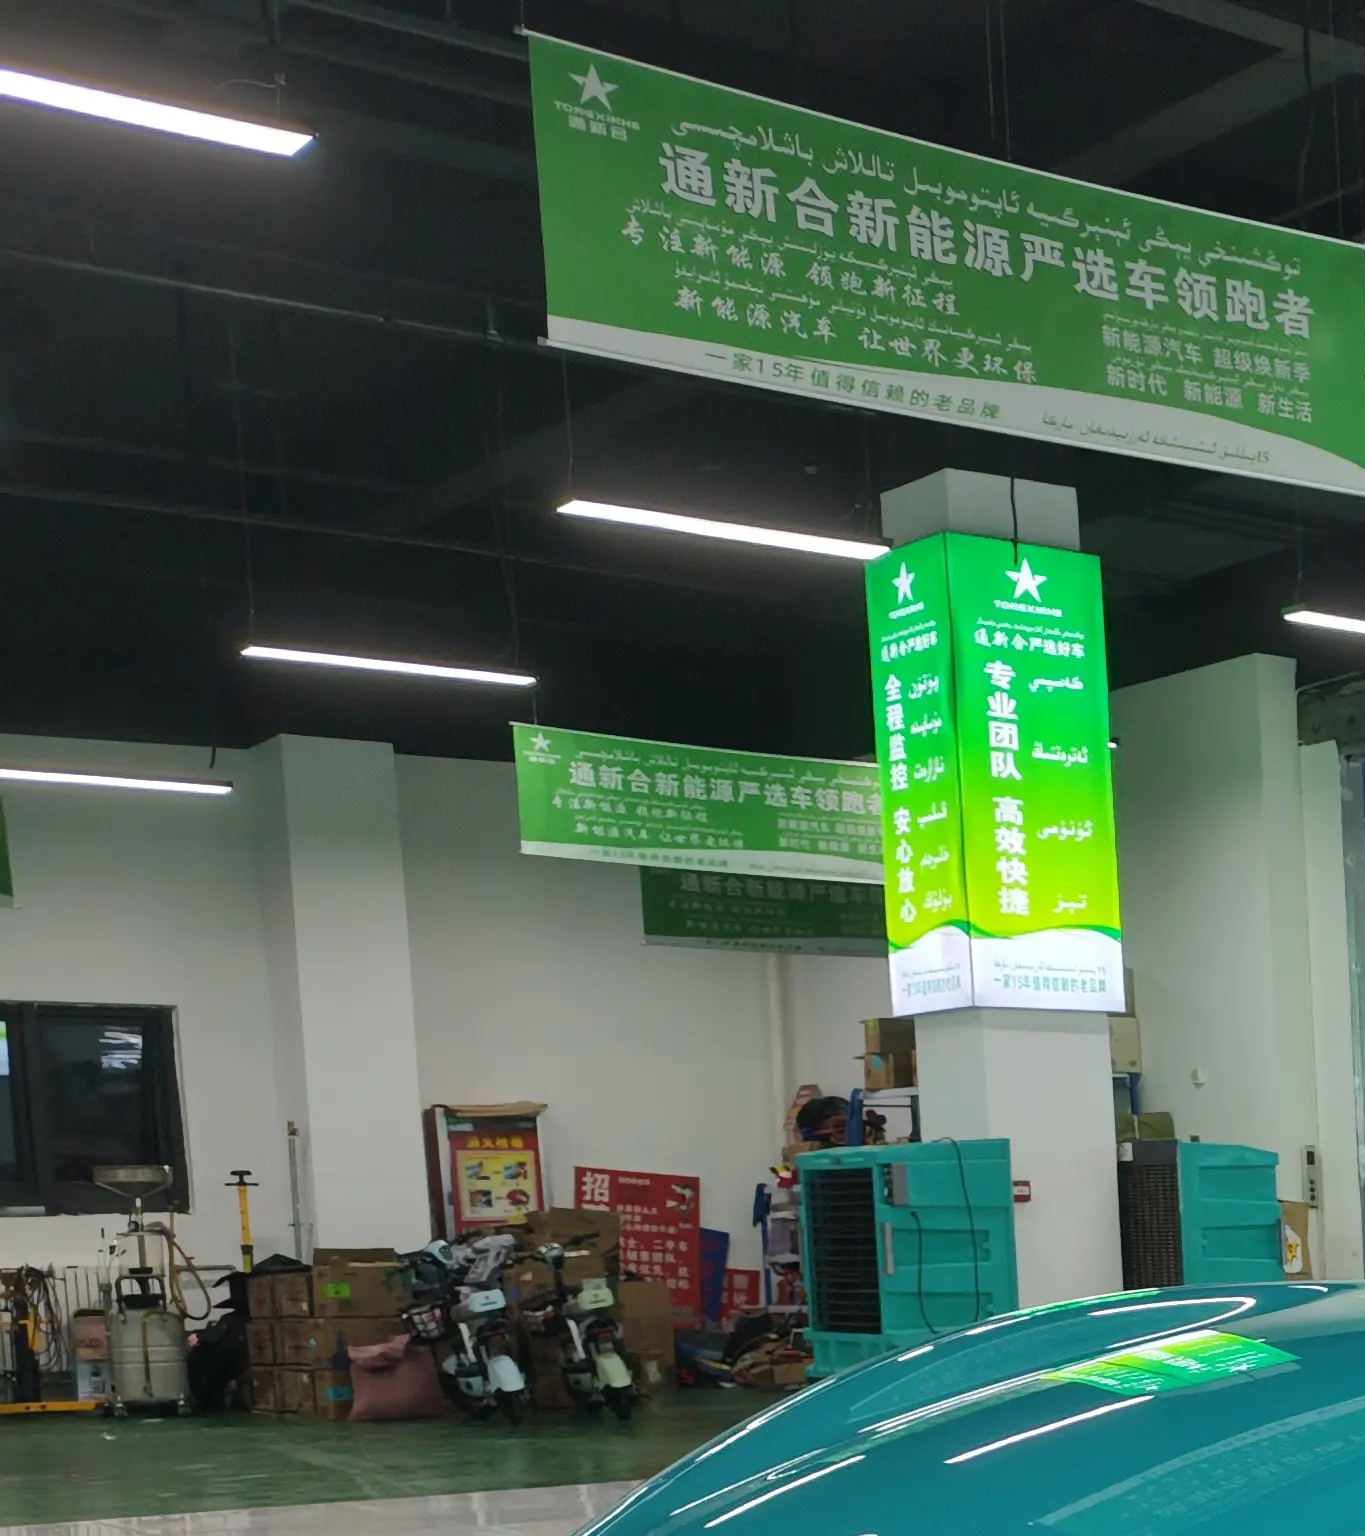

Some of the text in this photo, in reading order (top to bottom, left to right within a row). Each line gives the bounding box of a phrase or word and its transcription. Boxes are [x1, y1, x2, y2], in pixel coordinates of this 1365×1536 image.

[670, 120, 815, 167] باشلامچىسى
[822, 146, 895, 182] تاللاش
[621, 214, 787, 278] 专注新能源
[804, 261, 961, 316] 领跑新征程
[658, 141, 1316, 340] 通新合新能源严选车领跑者
[674, 284, 838, 345] 新能源汽车
[856, 326, 1037, 383] 让世界更环保
[1100, 323, 1204, 366] 新能源汽车
[704, 352, 1001, 421] 一家15年值得信赖的老品牌
[1106, 363, 1168, 397] 新时代
[1182, 378, 1245, 410] 新能源
[1256, 391, 1313, 424] 新生活
[982, 658, 1032, 917] 专业团队 高效快捷
